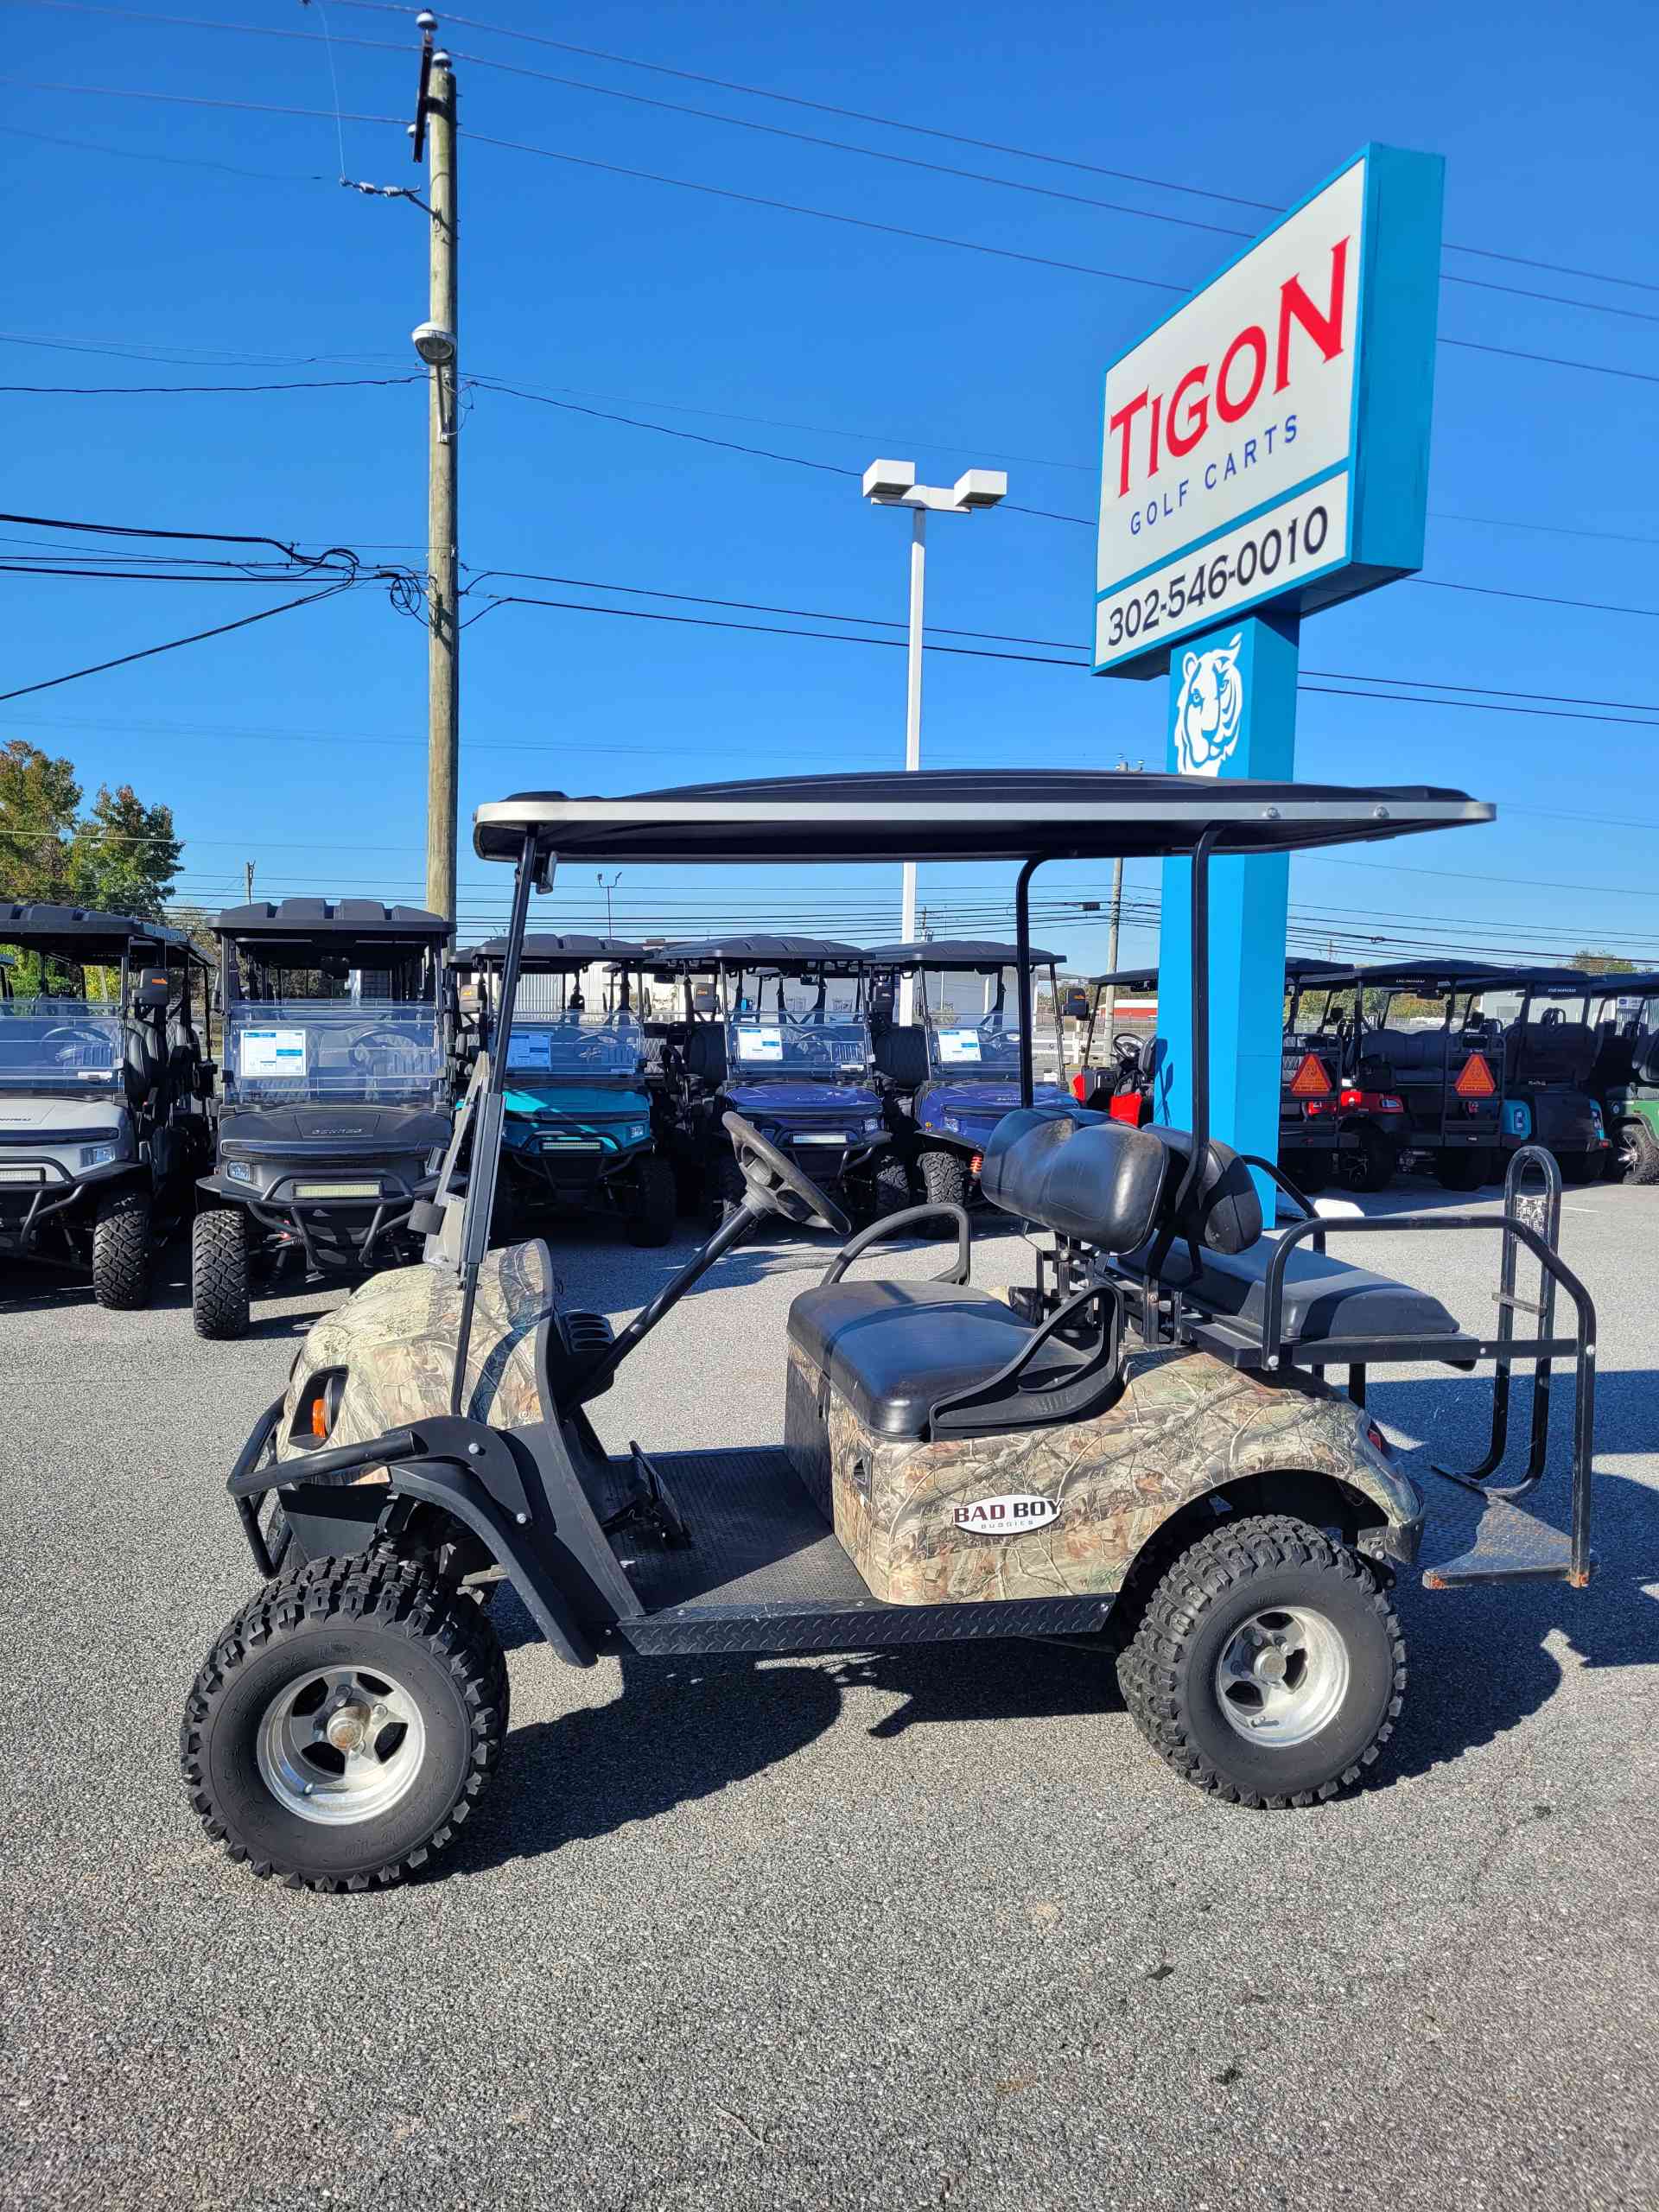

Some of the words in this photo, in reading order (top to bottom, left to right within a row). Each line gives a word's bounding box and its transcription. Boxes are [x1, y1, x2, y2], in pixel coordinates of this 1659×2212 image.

[1110, 235, 1351, 498] TIGON
[1129, 479, 1190, 535] GOLF
[1205, 415, 1298, 489] CARTS
[1108, 505, 1329, 646] 302-546-0010
[954, 1505, 1005, 1522] BAD
[1014, 1500, 1063, 1517] BOY
